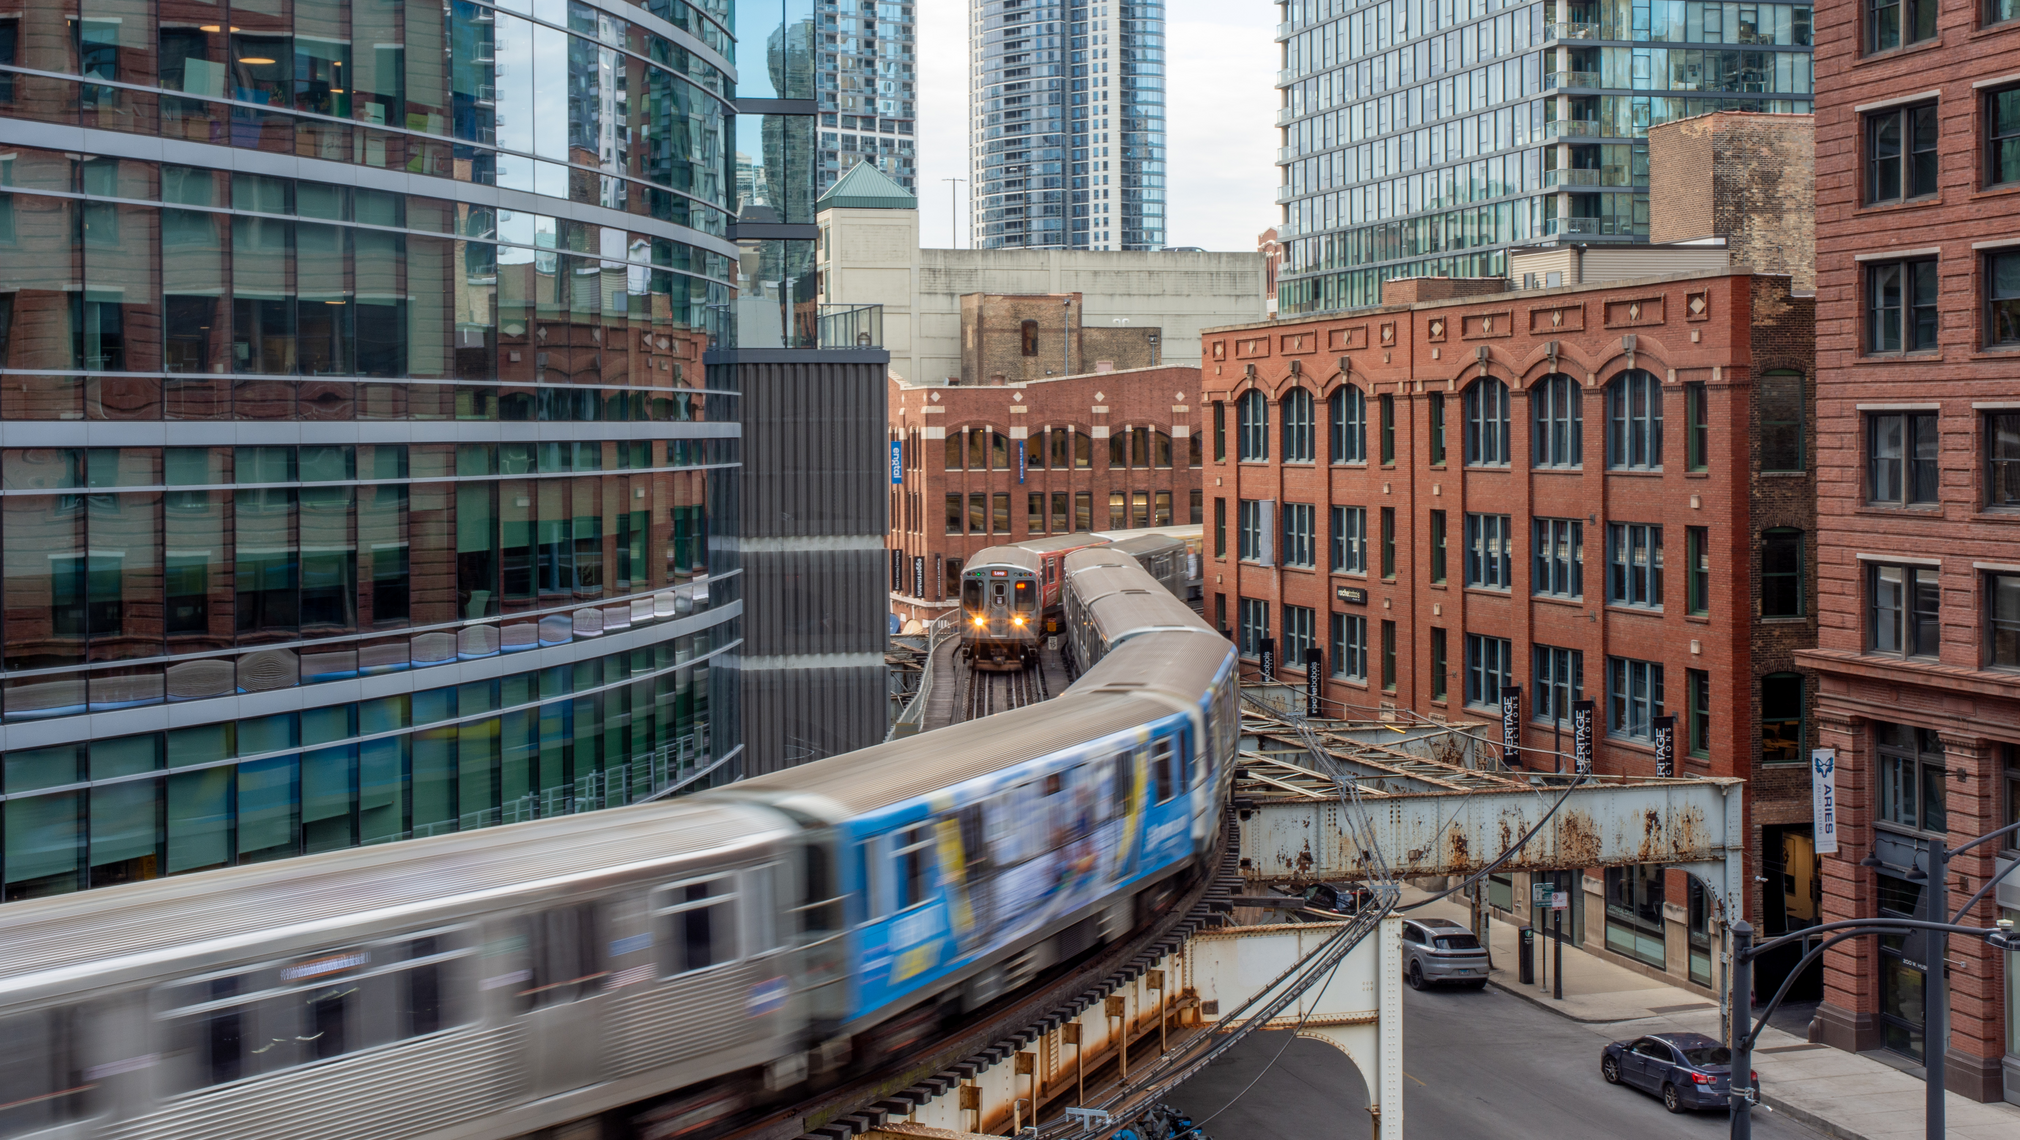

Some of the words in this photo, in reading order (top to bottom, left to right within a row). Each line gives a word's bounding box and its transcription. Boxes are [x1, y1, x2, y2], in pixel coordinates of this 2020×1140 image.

[891, 447, 902, 479] engtal
[915, 558, 923, 597] eggersmann
[1310, 661, 1318, 714] rochebobois
[1504, 696, 1513, 756] HERITAGE
[1655, 728, 1666, 778] RITAGE
[1823, 784, 1834, 834] ARIES
